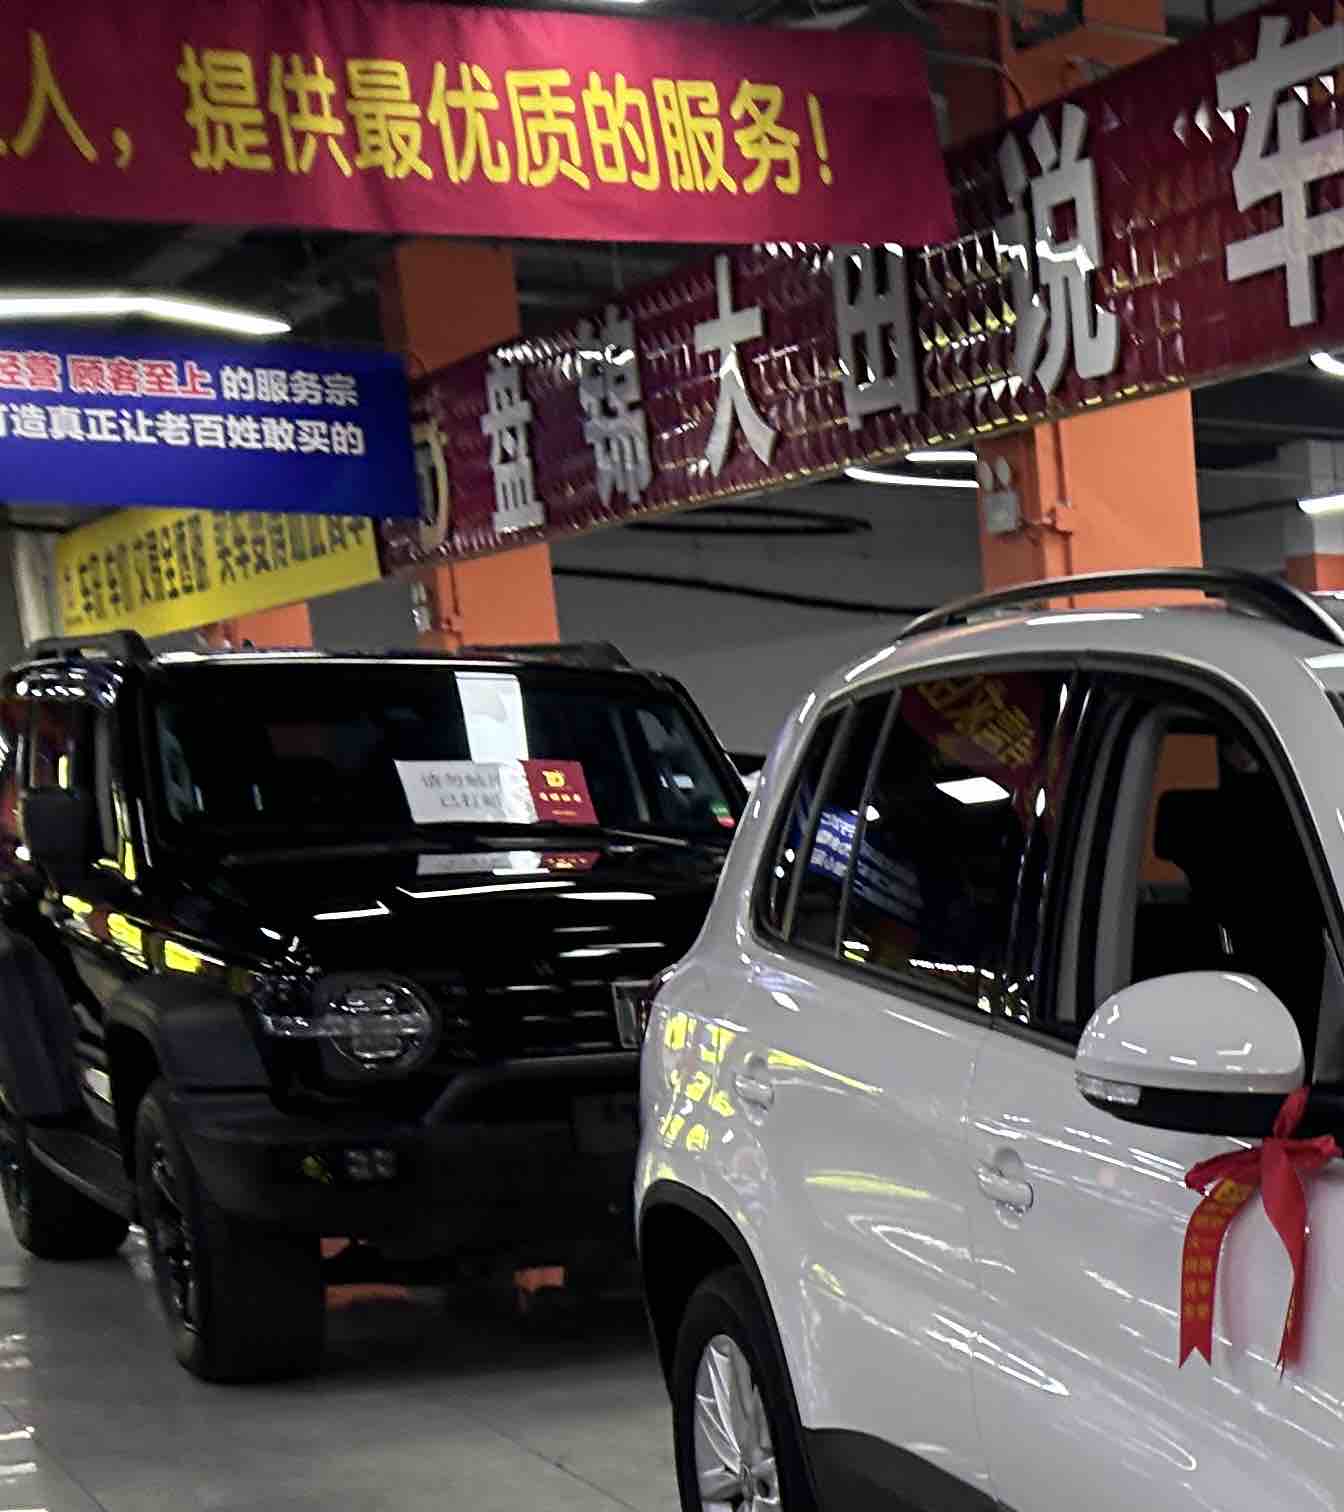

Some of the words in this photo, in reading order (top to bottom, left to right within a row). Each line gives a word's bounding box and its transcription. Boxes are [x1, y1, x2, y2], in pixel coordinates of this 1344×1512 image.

[0, 30, 832, 194] 人，提供最优质的服务！
[0, 402, 366, 456] 造真正让老百姓敢买的
